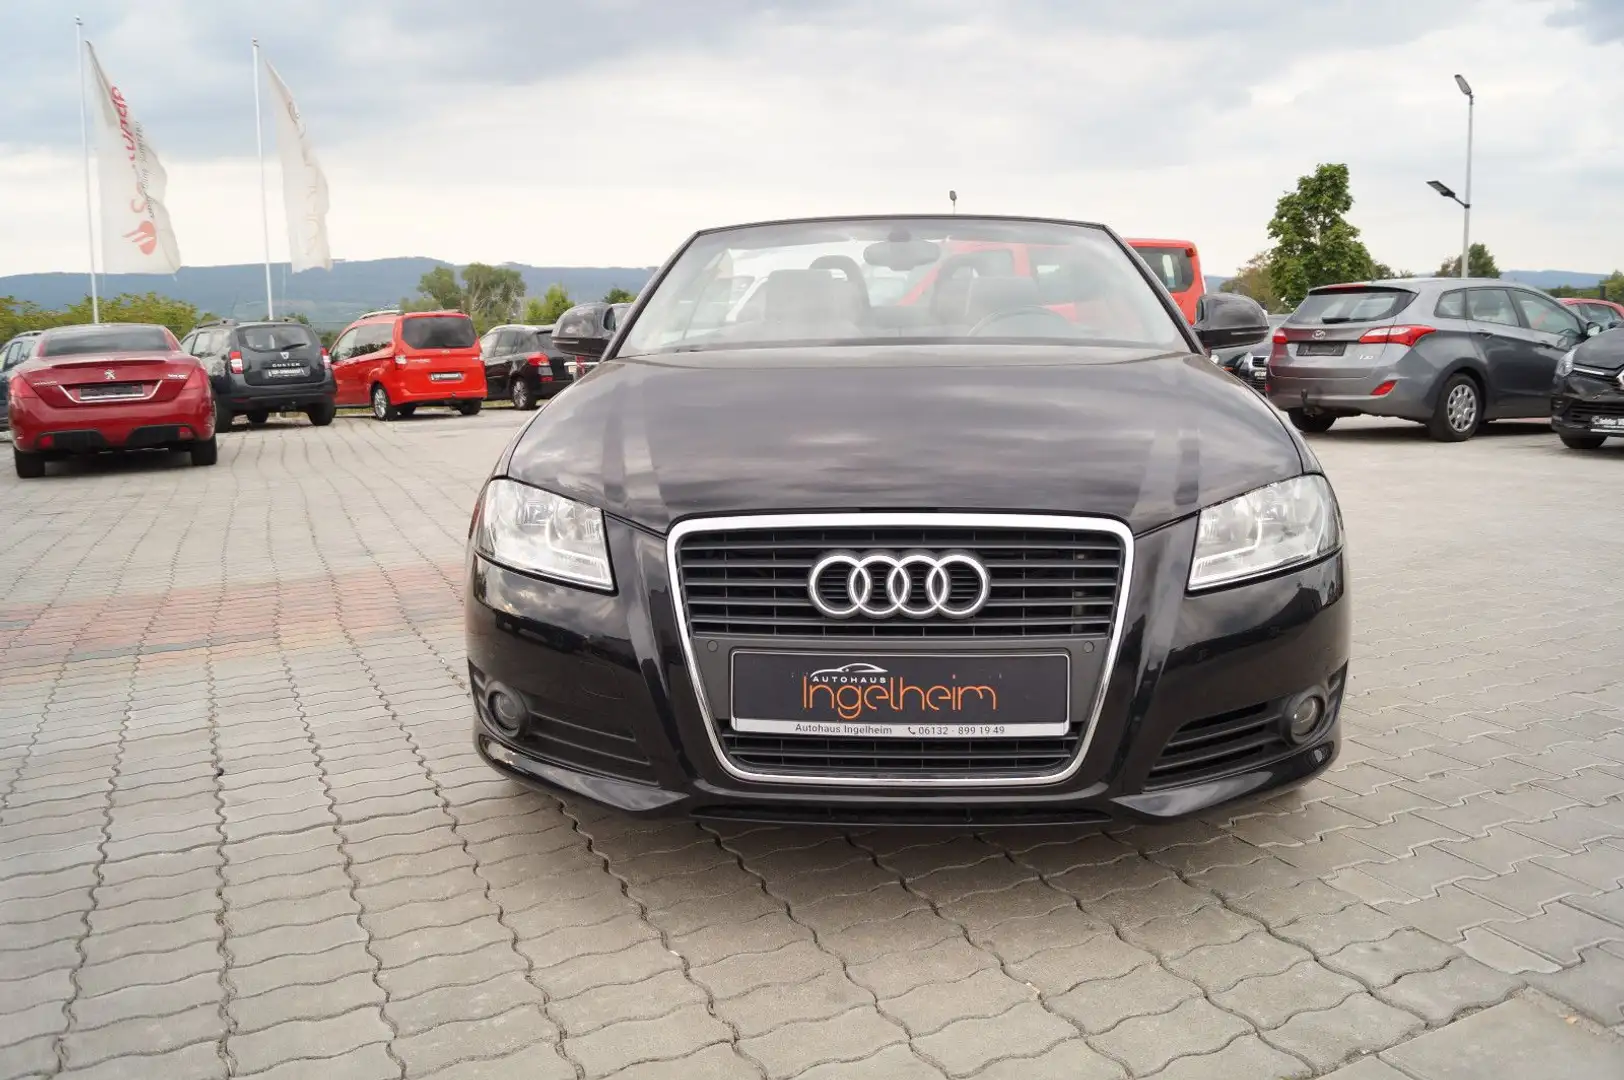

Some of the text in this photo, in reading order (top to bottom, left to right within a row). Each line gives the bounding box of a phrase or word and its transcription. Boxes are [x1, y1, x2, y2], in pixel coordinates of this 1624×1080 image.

[812, 675, 887, 684] AUTOHAUS
[803, 674, 997, 719] Ingelheim
[795, 723, 841, 734] Autohaus
[844, 725, 893, 735] Ingelheim
[918, 726, 949, 735] 06132
[958, 726, 976, 735] 899
